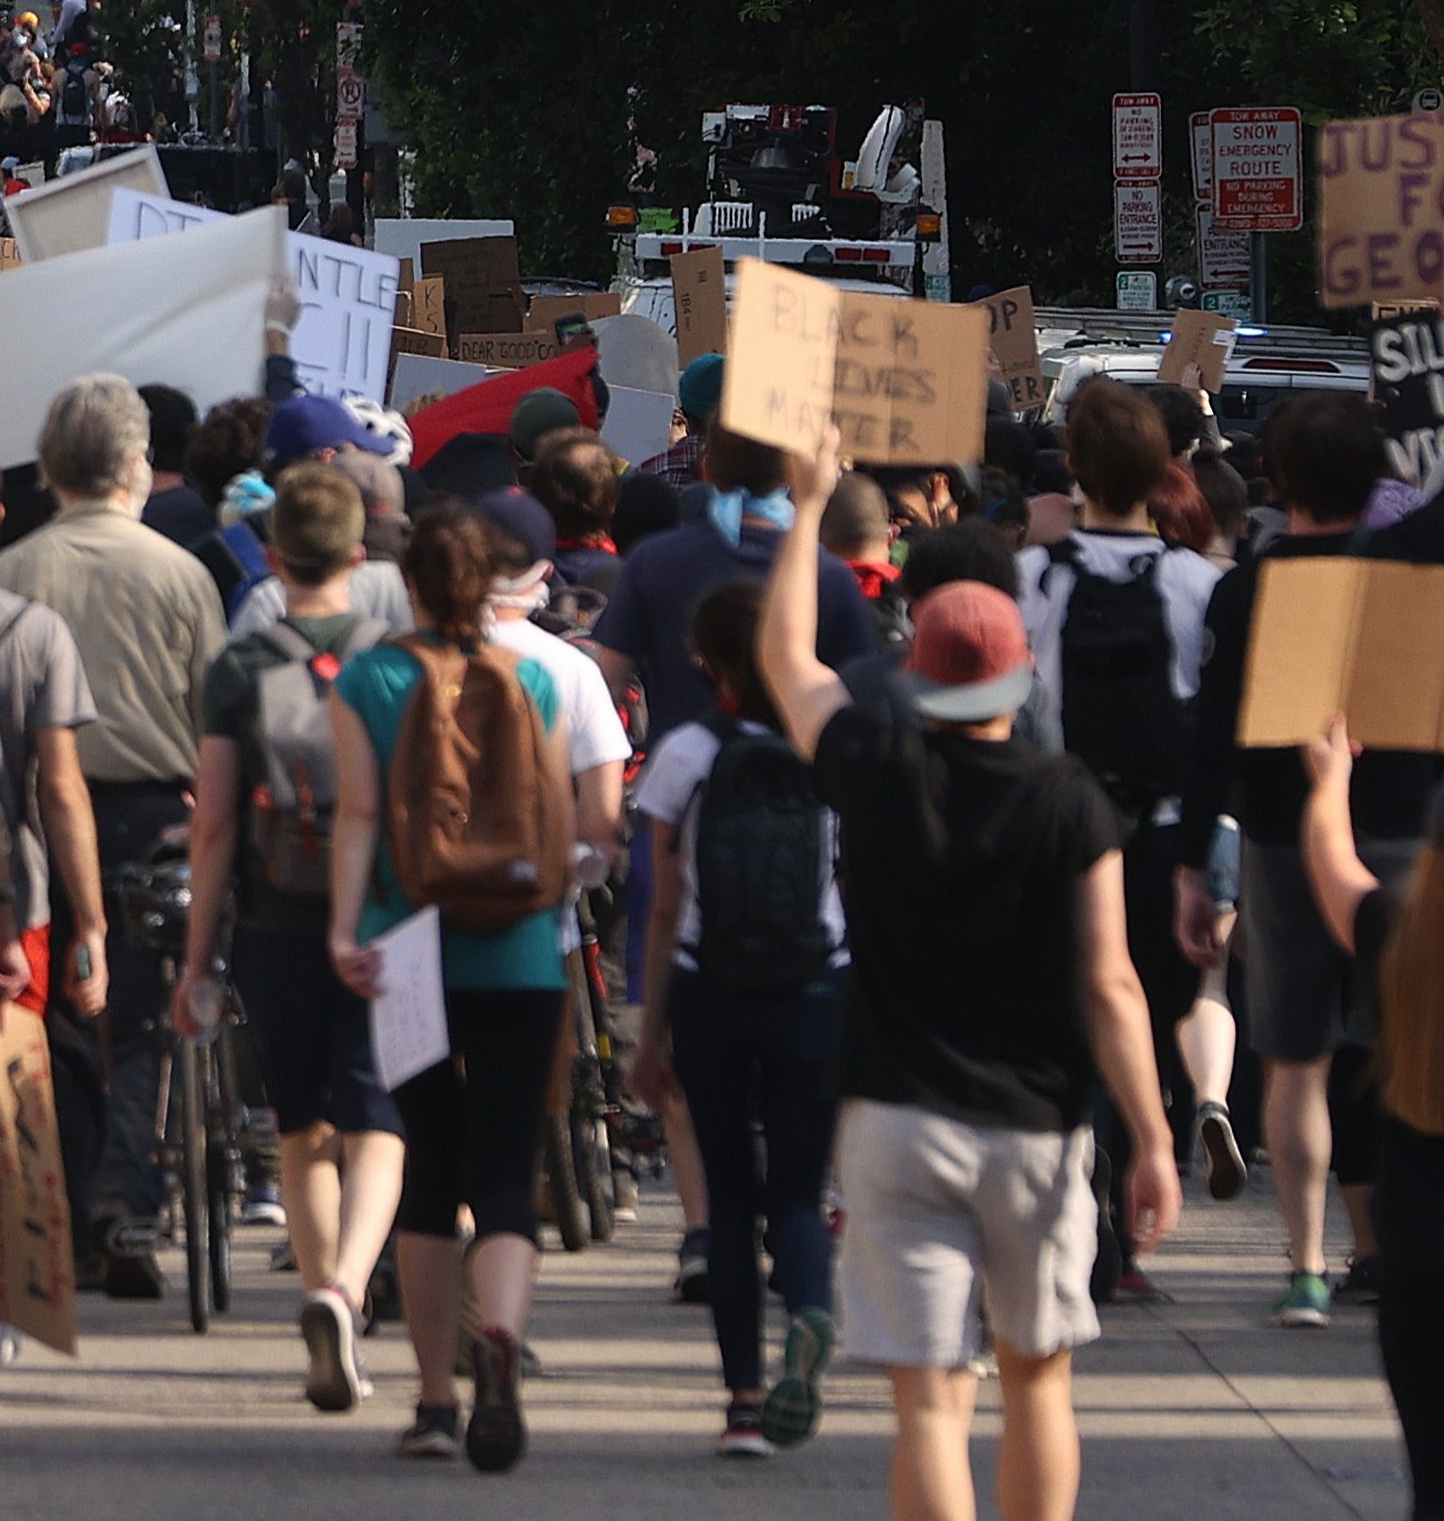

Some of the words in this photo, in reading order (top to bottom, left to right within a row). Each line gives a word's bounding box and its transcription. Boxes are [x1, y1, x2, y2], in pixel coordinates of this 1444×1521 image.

[1233, 125, 1278, 139] SNOW
[1219, 144, 1291, 157] EMERGENCY
[1230, 161, 1282, 176] ROUTE
